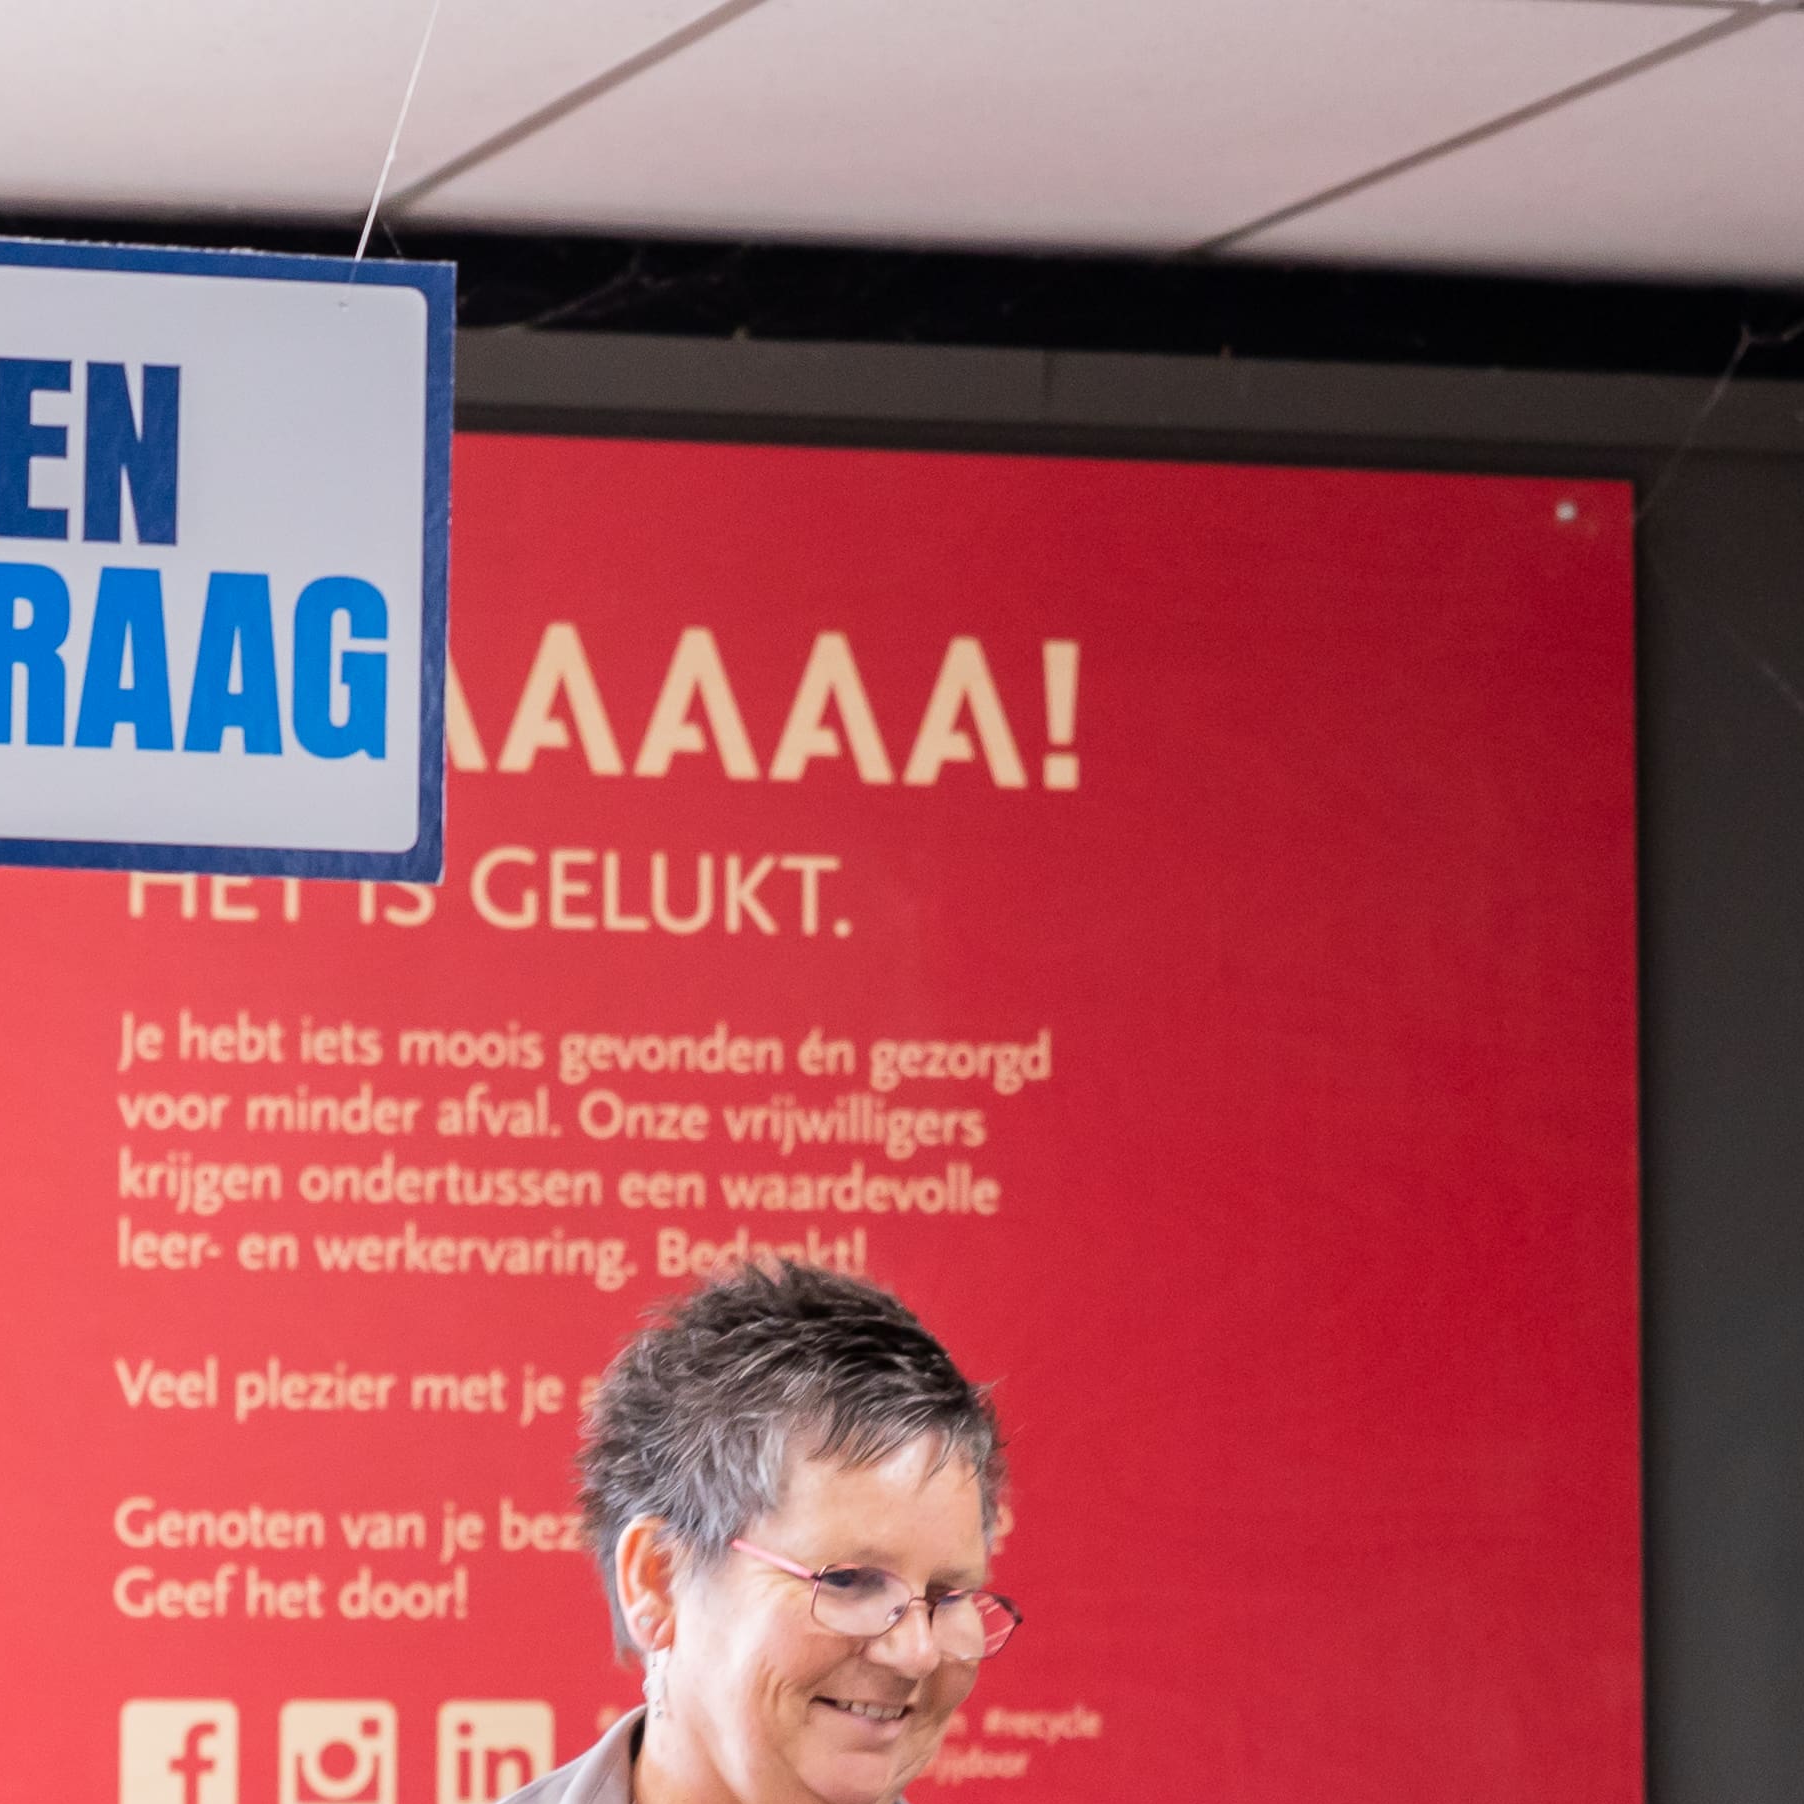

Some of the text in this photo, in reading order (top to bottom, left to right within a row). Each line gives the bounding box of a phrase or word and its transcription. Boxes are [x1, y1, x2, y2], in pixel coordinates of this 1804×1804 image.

[470, 846, 852, 937] GELUKT.
[119, 1011, 1052, 1094] Je hebt iets moois gevonden én gezorgd
[118, 1086, 987, 1159] voor minder afval. Onze vrijwilligers
[118, 1149, 1001, 1216] krijgen ondertussen een waardevolle
[117, 1217, 222, 1270] leer-
[237, 1232, 299, 1271] en
[314, 1222, 637, 1291] werkervaring.
[114, 1357, 218, 1409] Veel
[235, 1358, 396, 1422] plezier
[412, 1368, 506, 1413] met
[520, 1366, 564, 1425] je
[114, 1496, 586, 1563] Genoten van je bez
[113, 1564, 468, 1620] Geef het door!
